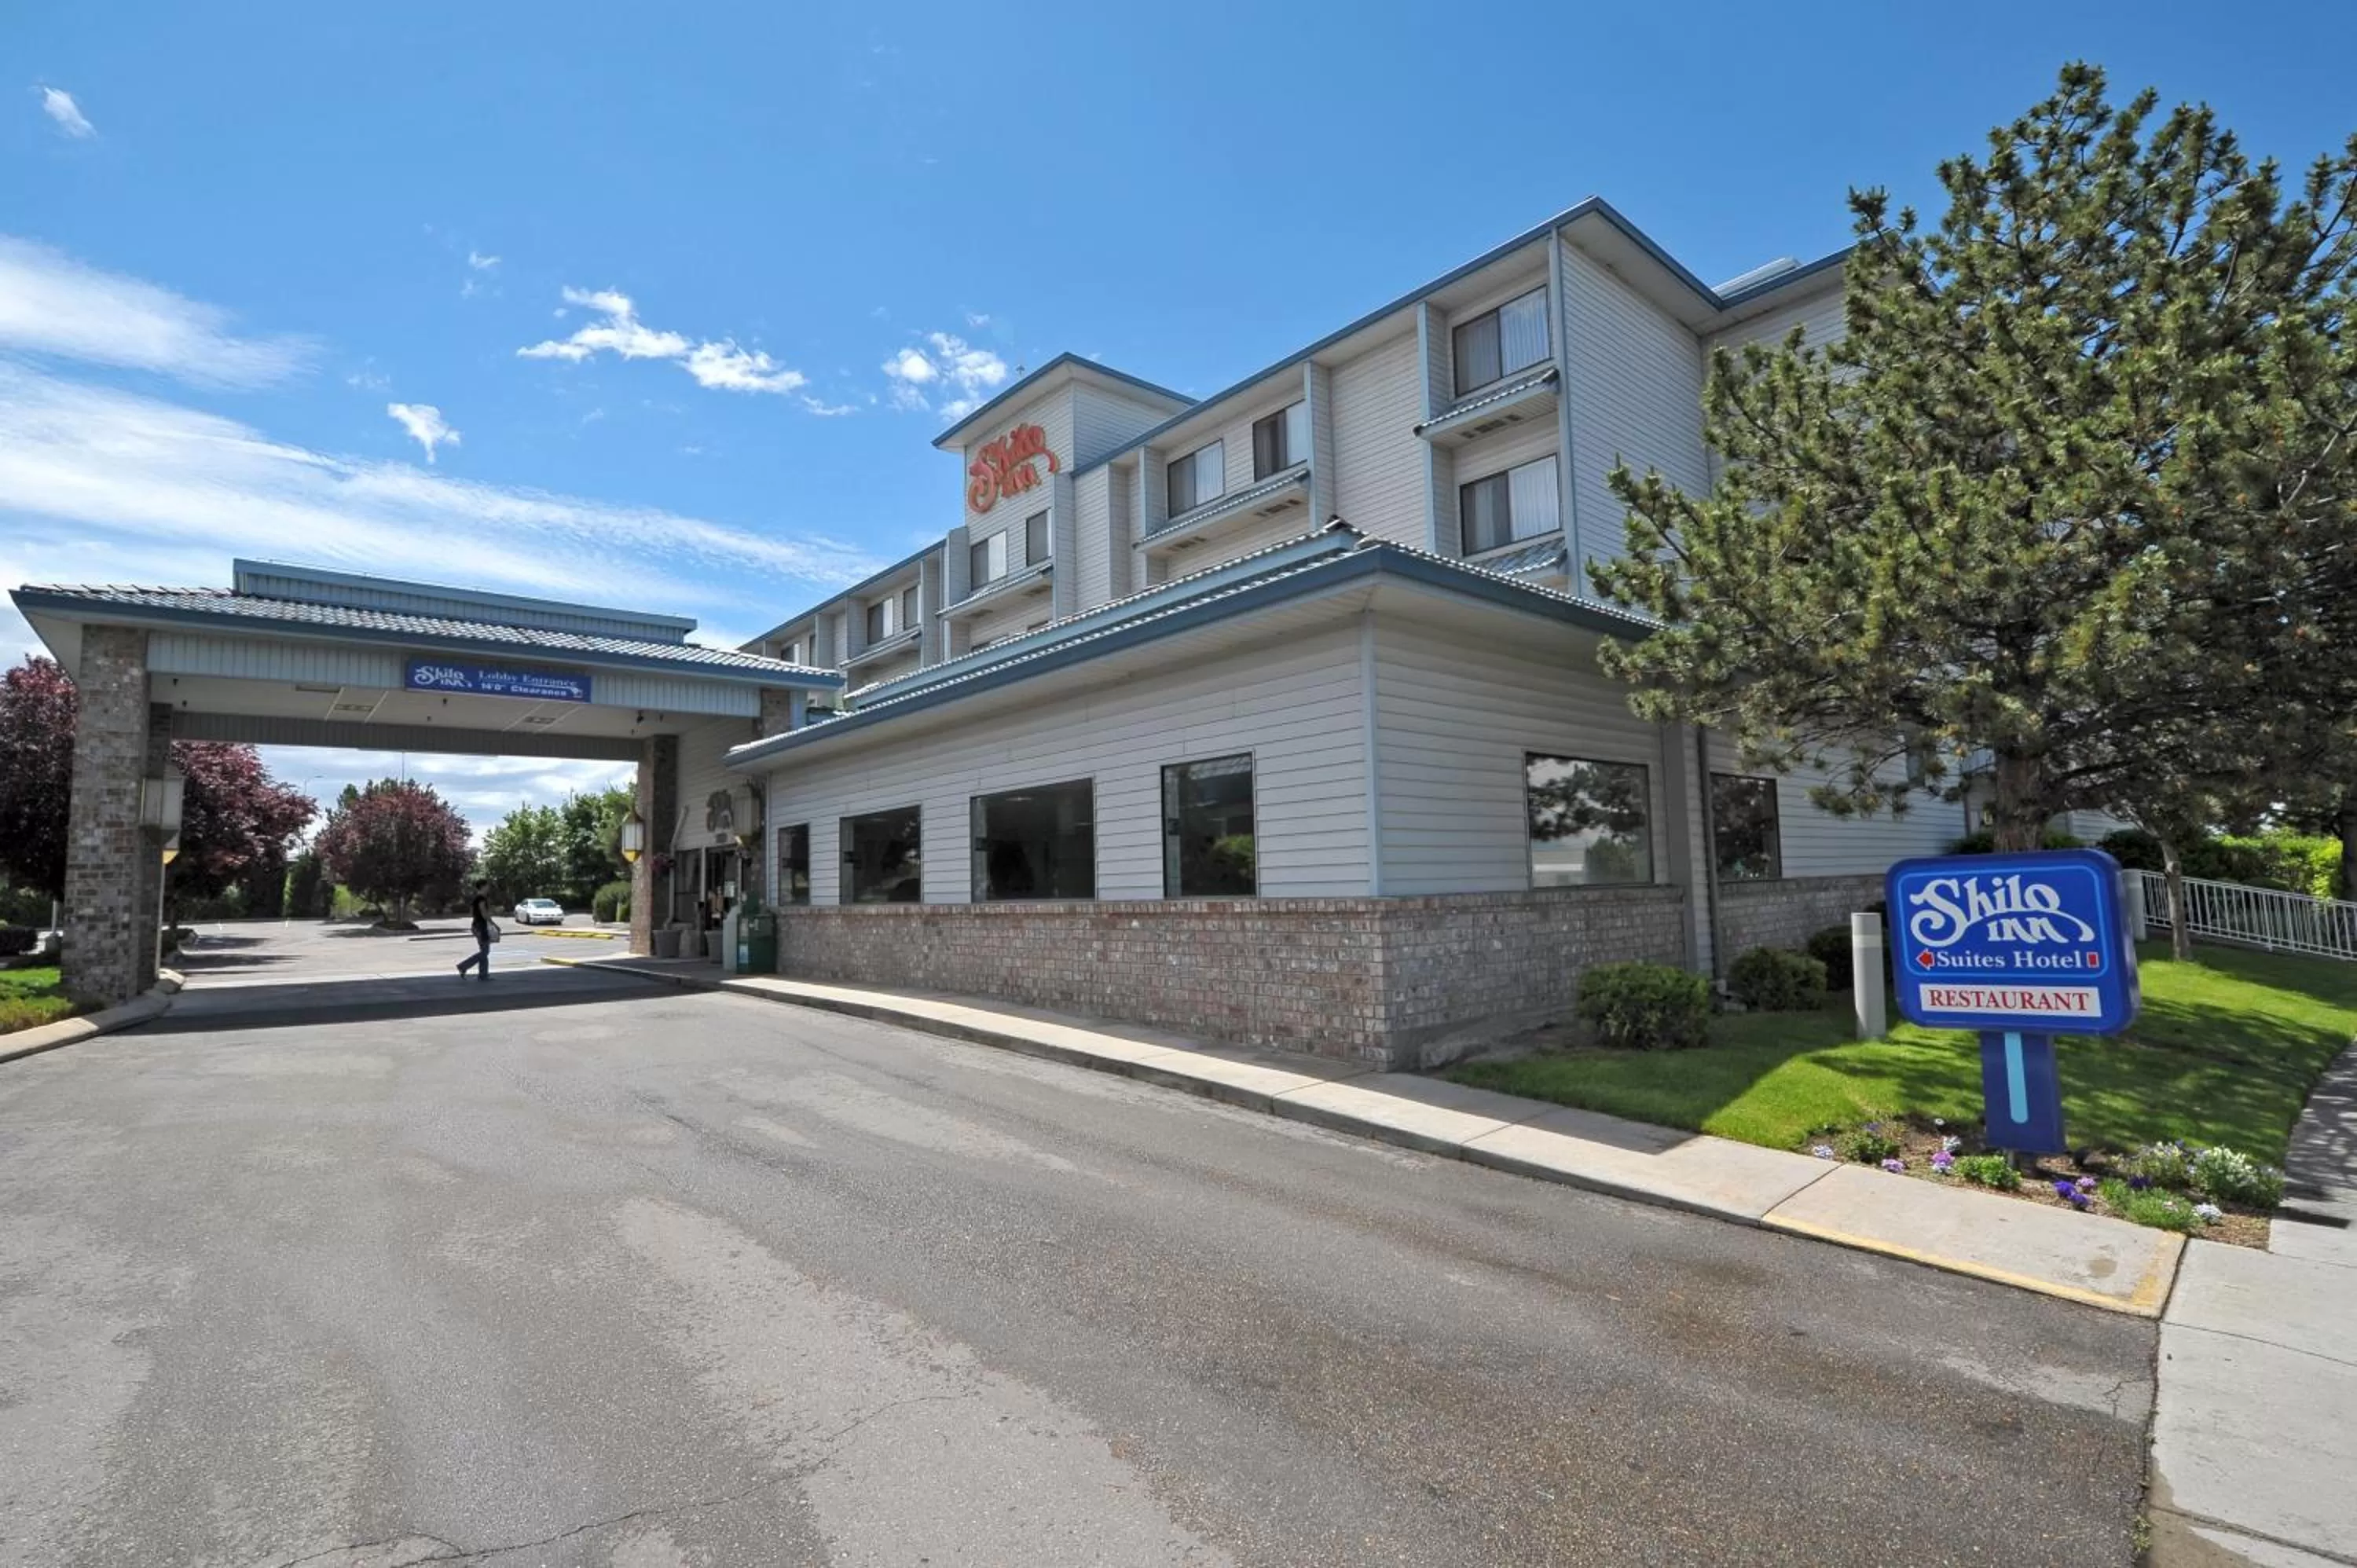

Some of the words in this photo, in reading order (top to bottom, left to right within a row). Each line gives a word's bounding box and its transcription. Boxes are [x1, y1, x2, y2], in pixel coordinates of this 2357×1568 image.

[968, 423, 1060, 514] Shilo
[414, 665, 472, 687] Shilo
[478, 670, 518, 682] Lobby
[522, 673, 577, 687] Entrance
[511, 685, 567, 697] Clearance
[1910, 874, 2095, 947] Shilo
[1937, 951, 2006, 969] Suites
[2013, 951, 2082, 969] Hotel
[1929, 990, 2089, 1011] RESTAURANT
